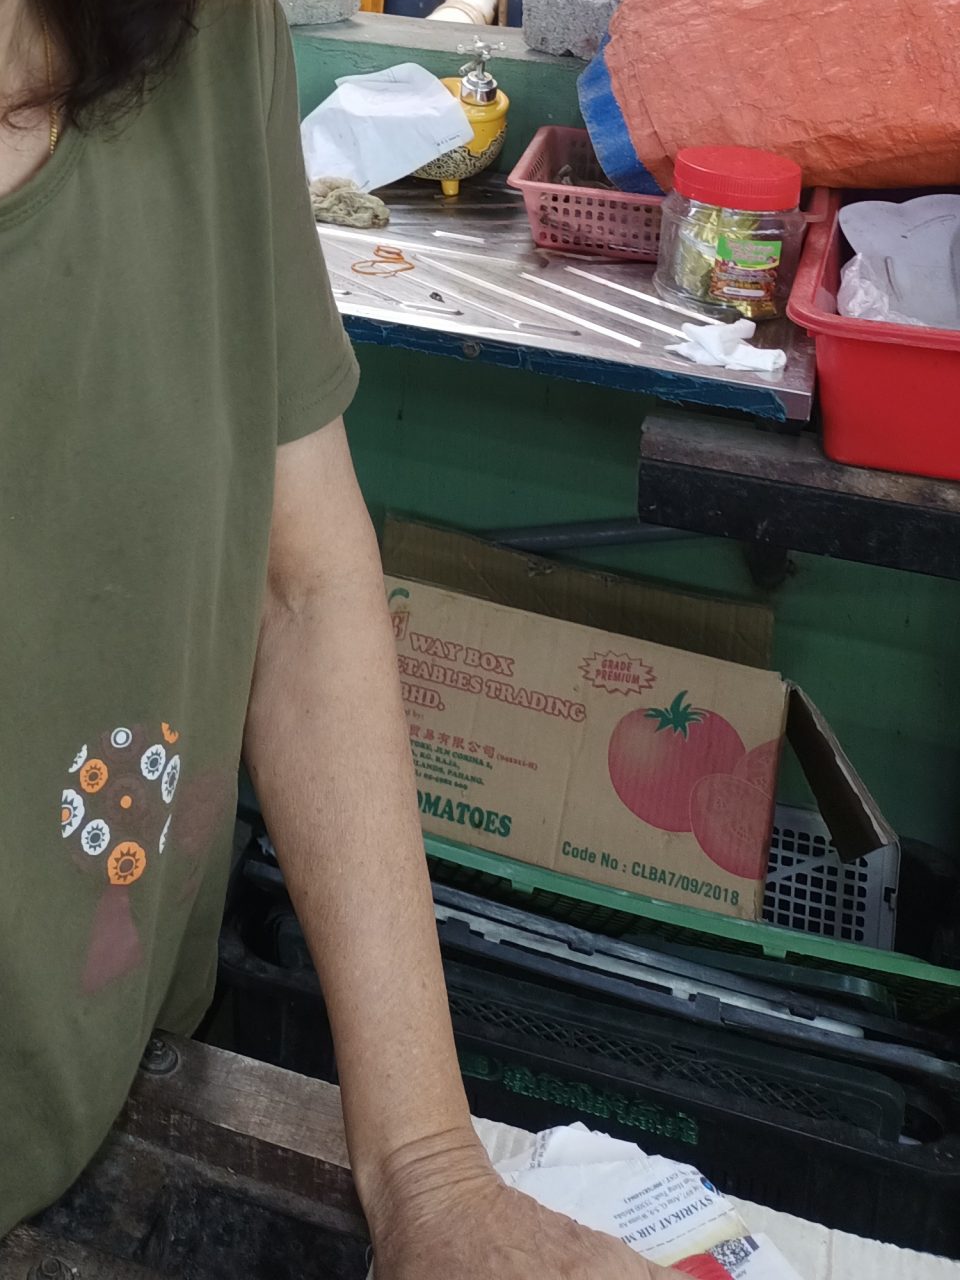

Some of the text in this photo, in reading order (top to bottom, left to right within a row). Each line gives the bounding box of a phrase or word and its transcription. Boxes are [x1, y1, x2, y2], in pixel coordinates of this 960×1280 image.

[409, 632, 515, 677] WAY BOX
[601, 659, 633, 672] GRADE
[595, 669, 640, 684] PREMIUM
[485, 679, 587, 722] TRADING
[561, 841, 597, 863] Code
[631, 861, 740, 906] CLBA7/09/2018
[659, 1195, 714, 1231] SYARIKAT
[635, 1224, 658, 1241] AIR
